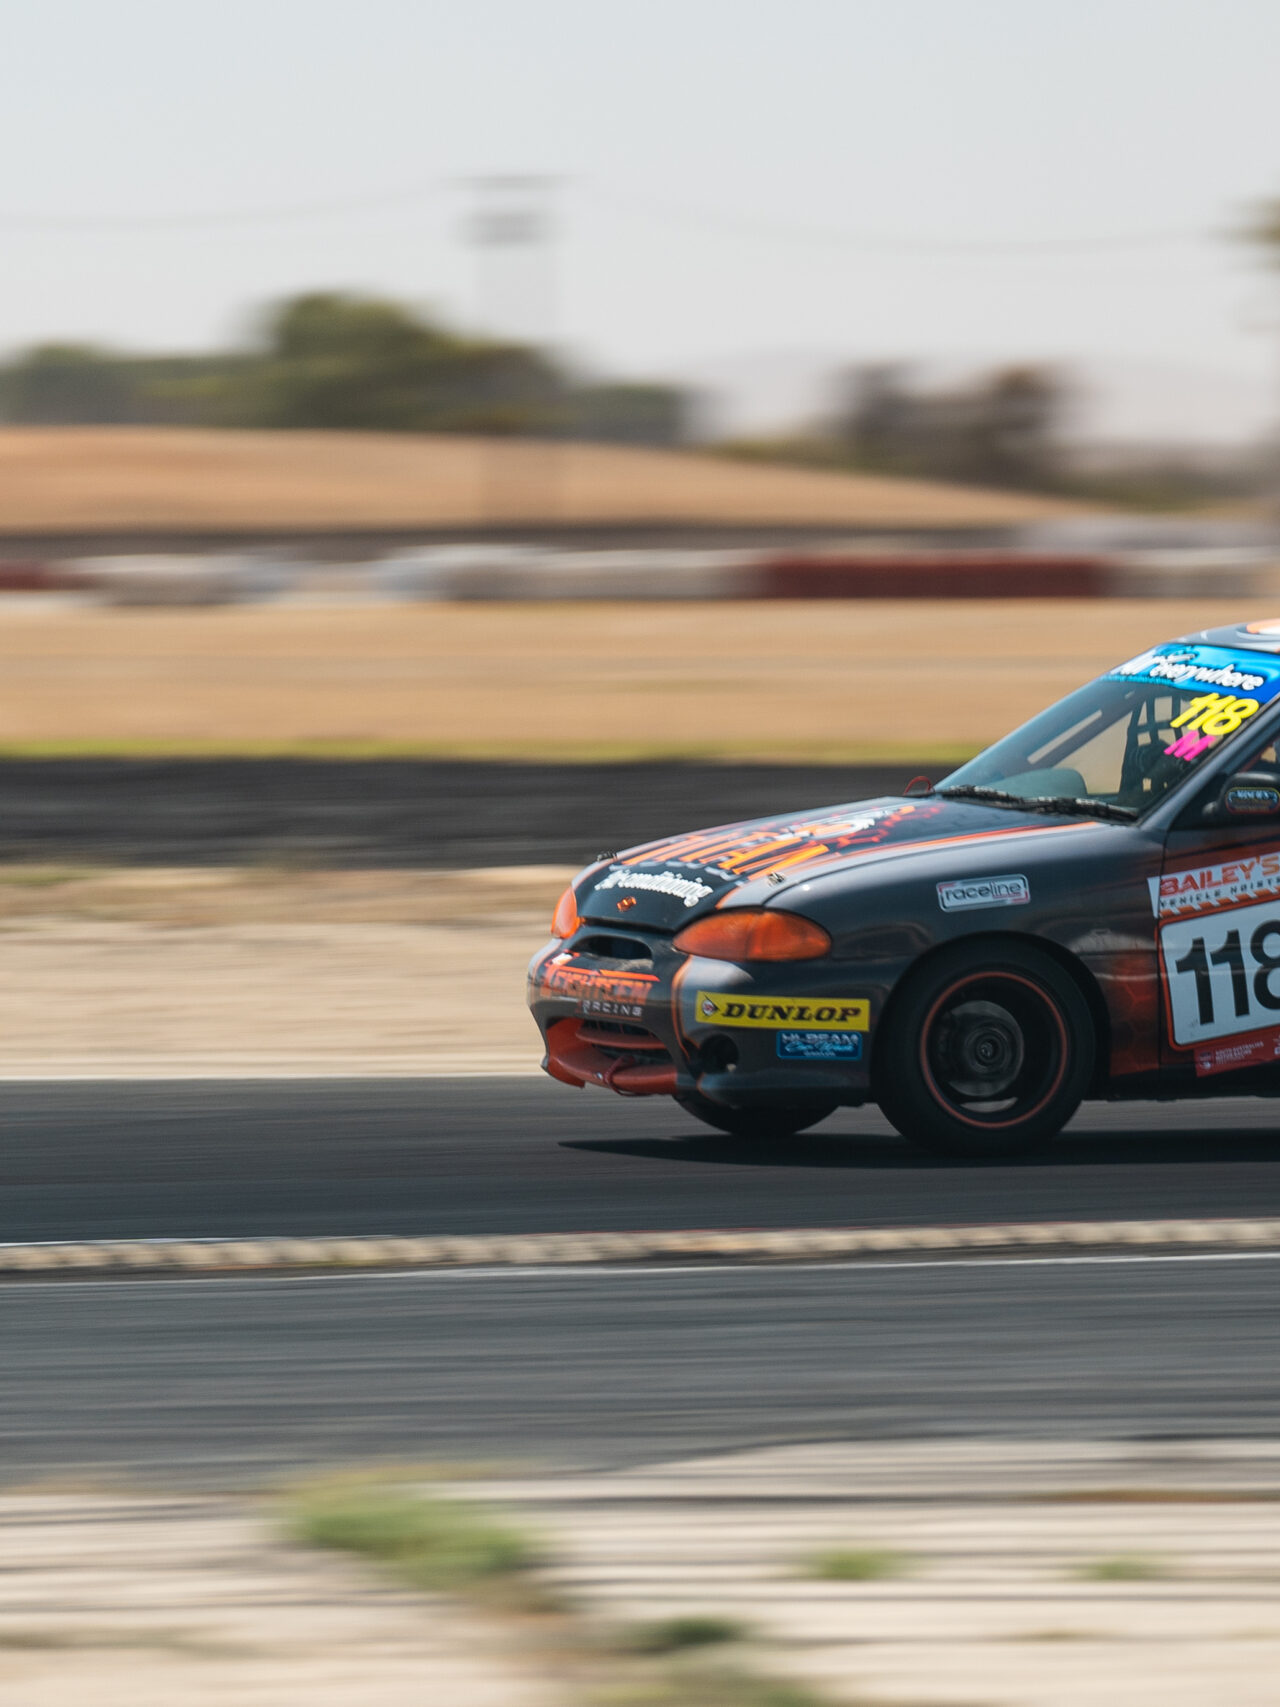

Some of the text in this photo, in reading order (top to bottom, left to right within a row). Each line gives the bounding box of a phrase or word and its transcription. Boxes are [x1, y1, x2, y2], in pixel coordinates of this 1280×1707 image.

[1169, 692, 1260, 736] 118
[945, 881, 1022, 901] raceline
[1160, 855, 1280, 897] BAILEY'S
[721, 1002, 862, 1023] DUNLOP
